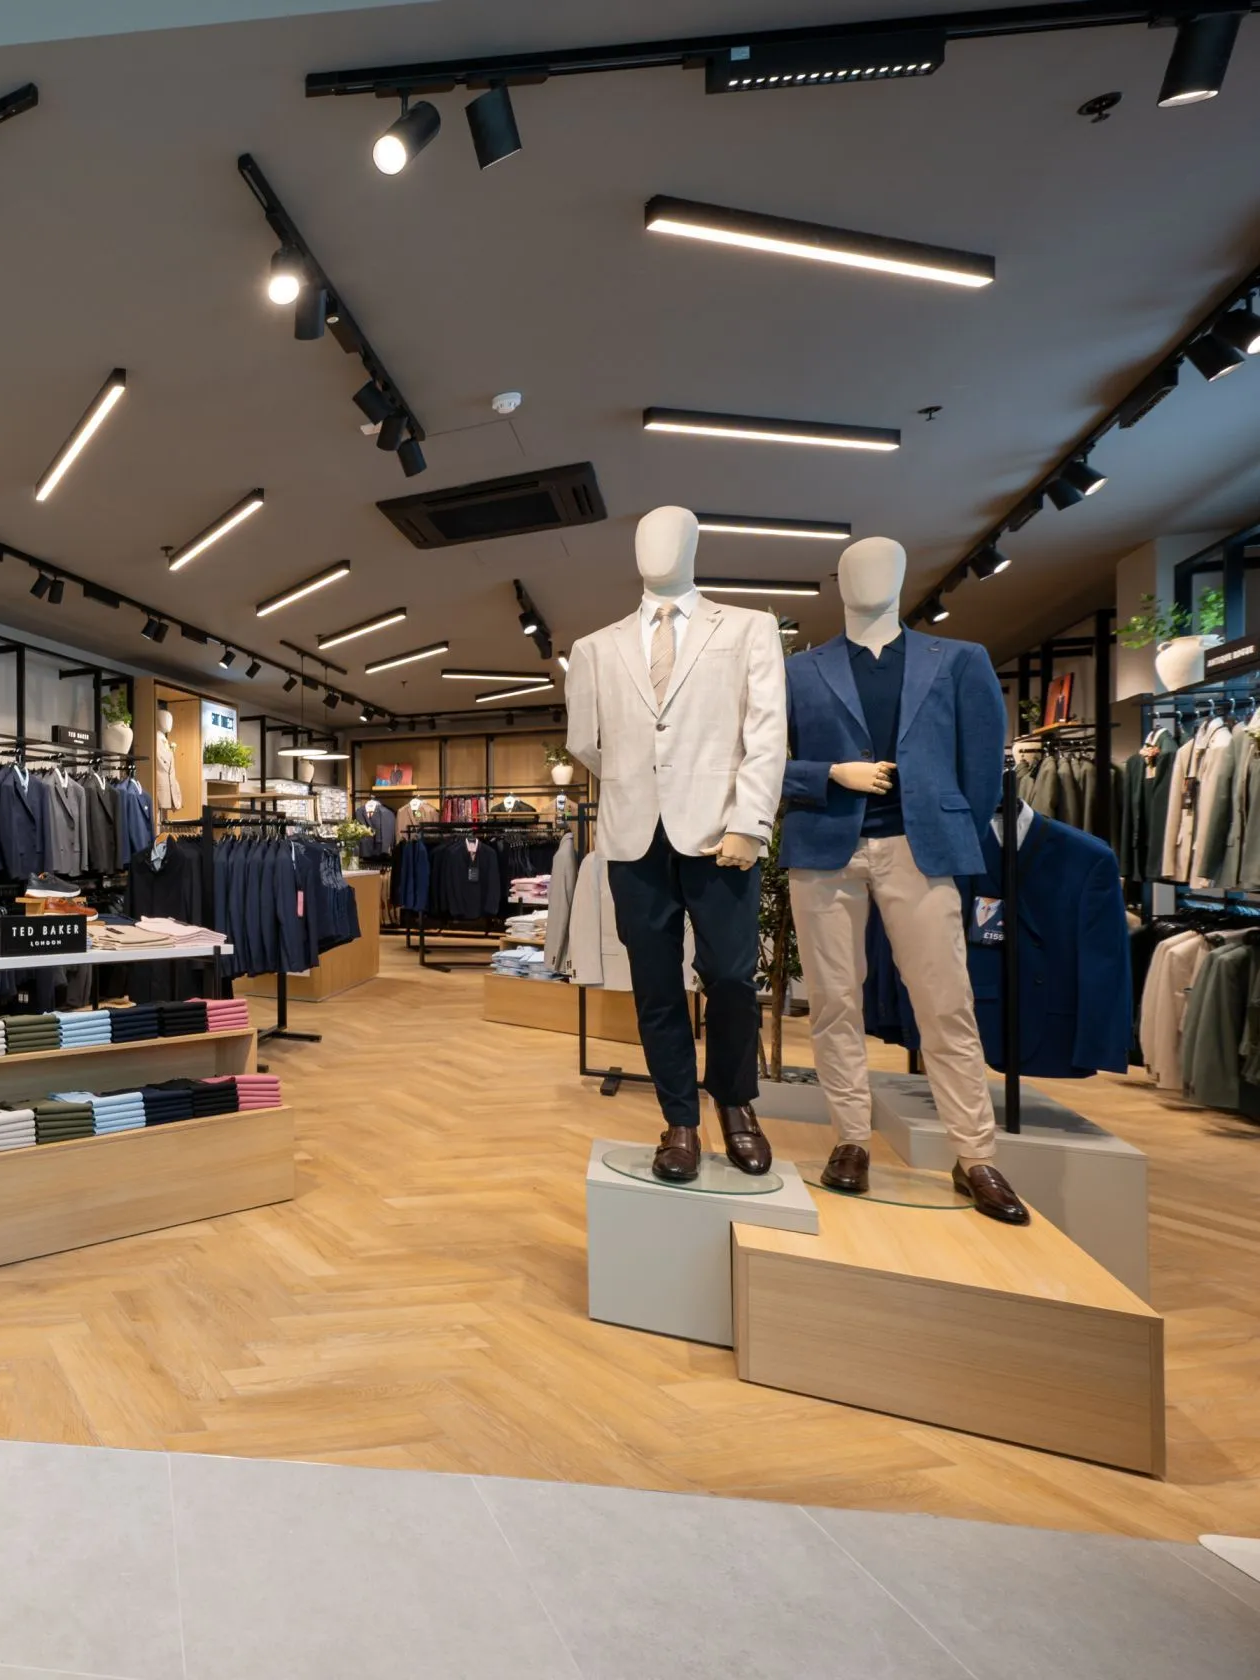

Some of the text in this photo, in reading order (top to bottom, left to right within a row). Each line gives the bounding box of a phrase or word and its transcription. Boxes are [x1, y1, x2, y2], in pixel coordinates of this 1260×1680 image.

[11, 924, 79, 937] TED BAKER
[30, 939, 62, 947] LONDON
